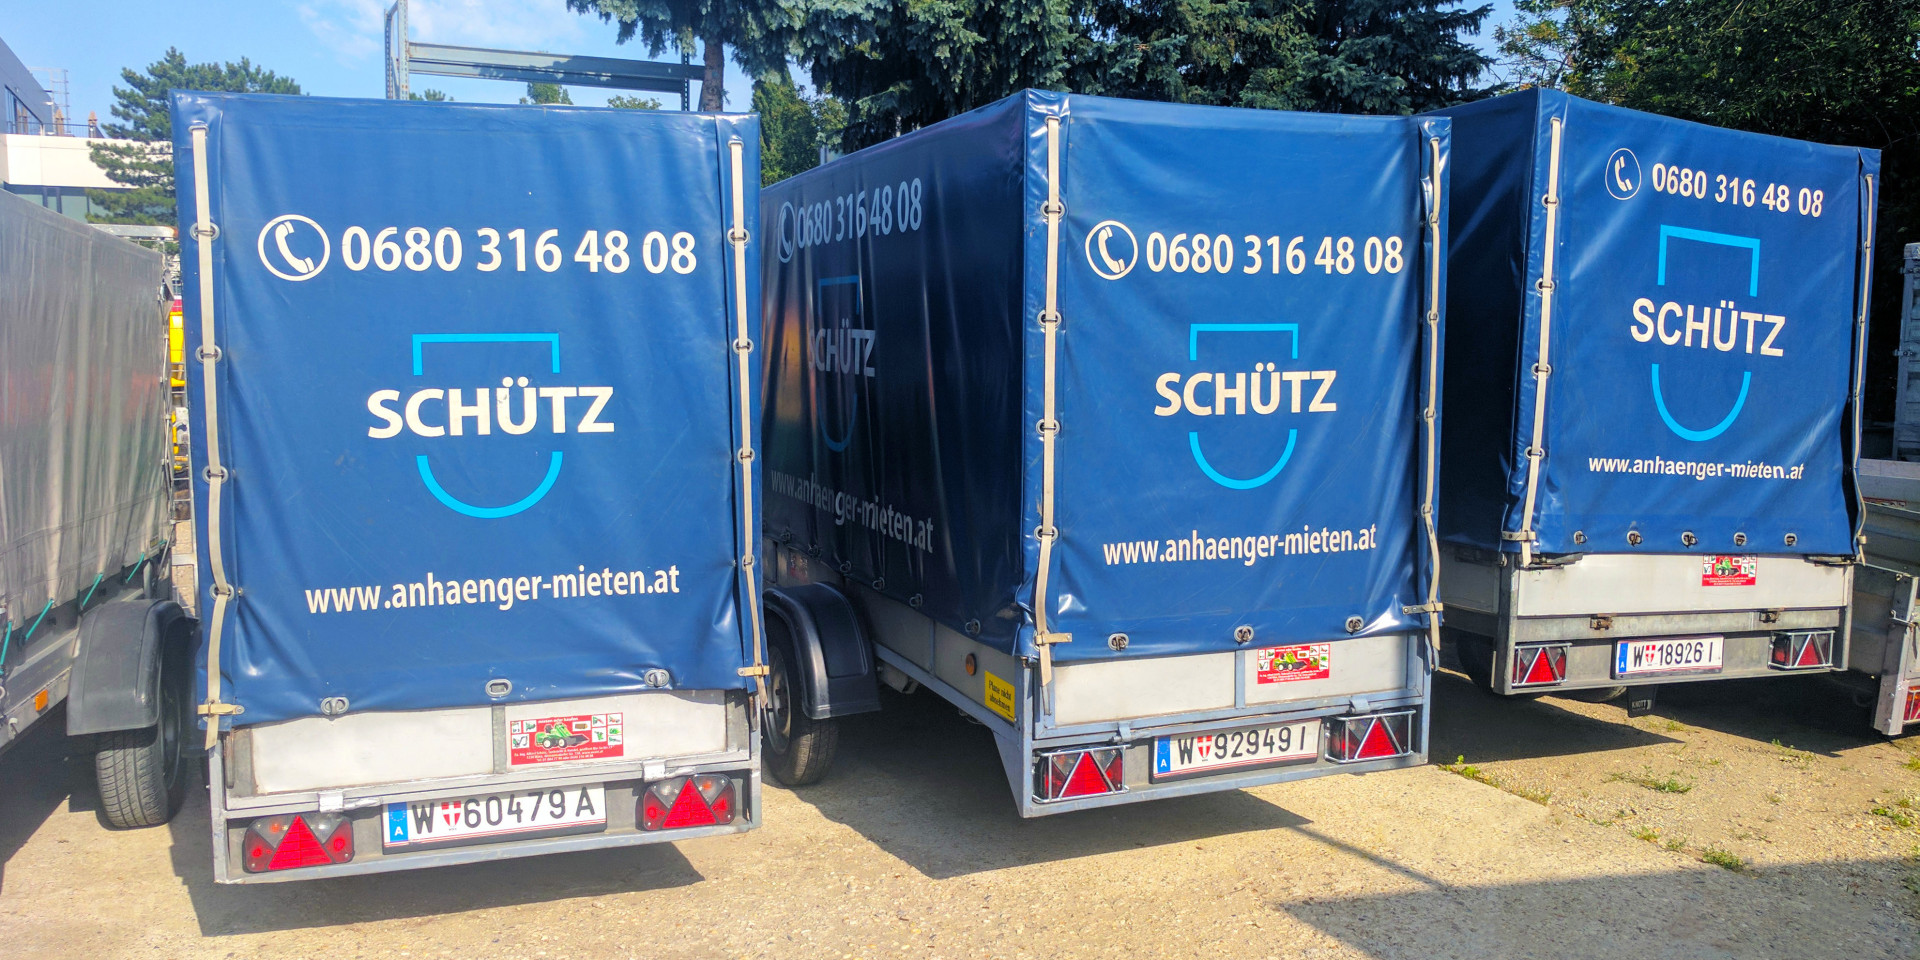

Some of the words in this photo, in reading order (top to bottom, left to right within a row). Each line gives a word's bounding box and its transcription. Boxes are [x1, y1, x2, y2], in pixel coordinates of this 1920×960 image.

[797, 199, 833, 249] 0680
[835, 190, 867, 243] 316
[869, 184, 893, 236] 48
[897, 177, 922, 231] 08
[1651, 163, 1707, 200] 0680
[1715, 174, 1757, 209] 316
[1762, 183, 1791, 214] 48
[1798, 188, 1825, 219] 08
[341, 226, 464, 272] 0680
[476, 228, 563, 273] 316
[573, 230, 631, 274] 48
[642, 231, 698, 275] 08
[1146, 231, 1234, 273] 0680
[1243, 234, 1307, 275] 316
[1314, 236, 1356, 275] 48
[1363, 236, 1405, 275] 08
[808, 317, 876, 377] SCHÜTZ
[1630, 297, 1787, 358] SCHÜTZ
[366, 376, 616, 439] SCHÜTZ
[1153, 362, 1338, 416] SCHÜTZ
[1588, 456, 1804, 481] www.anhaenger-mieten.at
[770, 469, 934, 554] www.anhaenger-mieten.at
[1103, 523, 1377, 567] www.anhaenger-mieten.at
[305, 564, 681, 615] www.anhaenger-mieten.at
[1633, 645, 1645, 668] W
[1657, 641, 1704, 667] 18926
[1160, 758, 1168, 768] A
[1177, 736, 1195, 766] W
[1214, 726, 1292, 760] 92949
[394, 826, 404, 836] A
[411, 802, 435, 835] W
[463, 789, 566, 829] 60479
[575, 786, 596, 817] A
